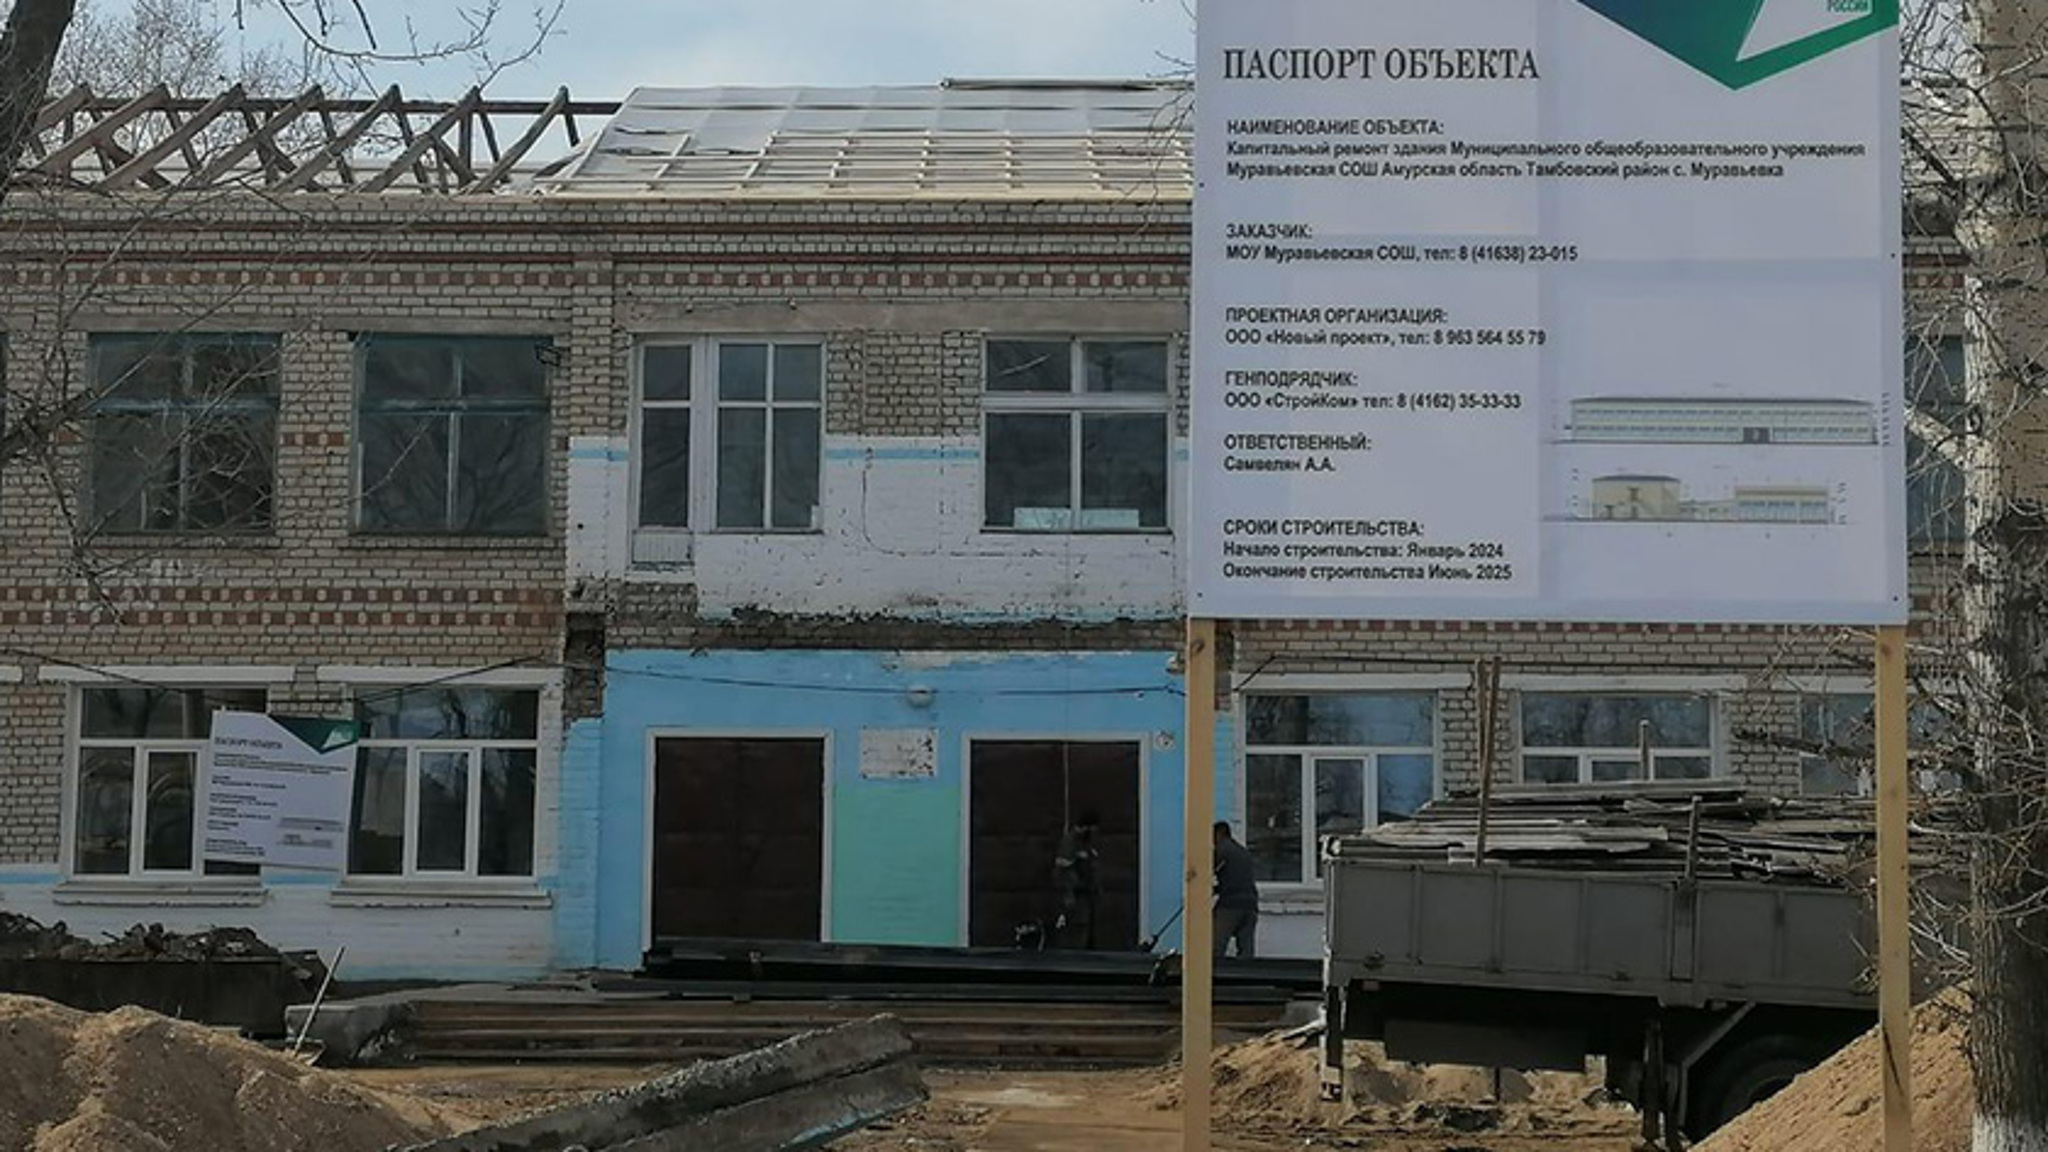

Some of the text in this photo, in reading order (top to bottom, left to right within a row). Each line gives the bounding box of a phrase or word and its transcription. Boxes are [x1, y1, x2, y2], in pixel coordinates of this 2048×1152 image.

[1223, 48, 1540, 80] ПАСПОРТ ОБЪЕКТА
[1227, 119, 1444, 135] НАИМЕНОВАНИЕ ОБЪЕКТА:
[1227, 140, 1865, 160] Капитальный ремонт здания Муниципального общеобразовательного учреждения
[1227, 161, 1784, 181] Муравьевская СОШ Амурская область Тамбовский район с. Муравьевка
[1226, 223, 1312, 239] ЗАКАЗЧИК:
[1226, 244, 1578, 264] МОУ Муравьевская СОШ, тел: 8 (41638) 23-015
[1226, 307, 1448, 325] ПРОЕКТНАЯ ОРГАНИЗАЦИЯ:
[1225, 328, 1261, 344] ООО
[1265, 329, 1327, 345] «Новый
[1330, 332, 1395, 347] проект»,
[1398, 333, 1430, 345] тел:
[1433, 329, 1443, 345] 8
[1477, 329, 1503, 345] 564
[1507, 329, 1525, 345] 55
[1528, 329, 1546, 345] 79
[1225, 371, 1358, 389] ГЕНПОДРЯДЧИК:
[1224, 391, 1521, 412] ООО «СтройКом» тел: 8 (4162) 35-33-33
[1224, 432, 1371, 451] ОТВЕТСТВЕННЫЙ:
[1224, 455, 1336, 472] Самвелян А.А.
[1224, 519, 1424, 537] СРОКИ СТРОИТЕЛЬСТВА:
[1224, 541, 1504, 560] Начало строительства: Январь 2024
[1223, 562, 1512, 581] Окончание строительства Июнь 2025
